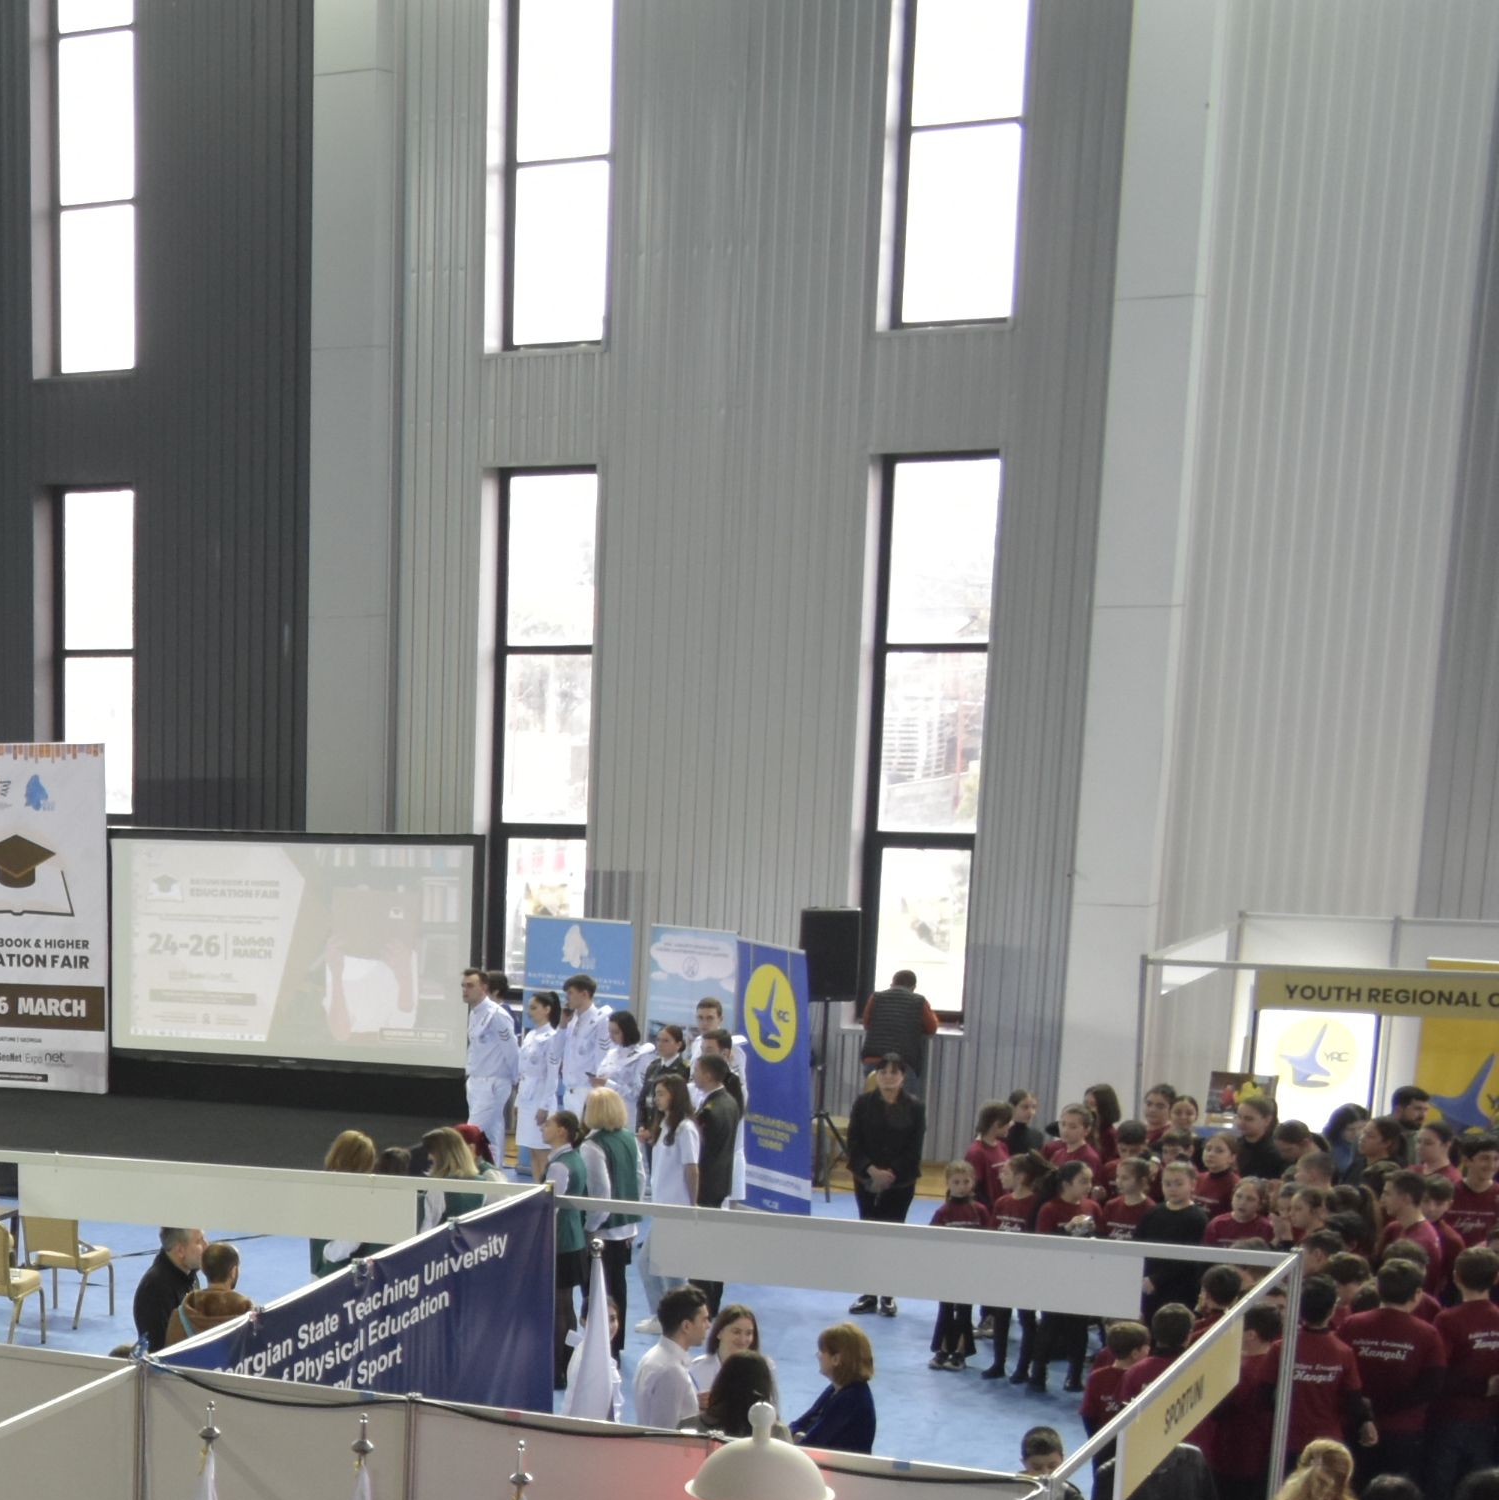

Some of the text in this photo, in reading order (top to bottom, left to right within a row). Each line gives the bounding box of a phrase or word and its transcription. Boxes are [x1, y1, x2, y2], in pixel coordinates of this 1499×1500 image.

[190, 888, 280, 899] EDUCATION FAIR
[34, 939, 42, 948] &
[45, 939, 89, 950] HIGHER
[148, 932, 220, 957] 24-26
[232, 948, 272, 959] MARCH
[51, 954, 90, 969] FAIR
[1286, 984, 1361, 1001] YOUTH
[1368, 988, 1481, 1008] REGIONAL
[17, 997, 86, 1017] MARCH
[25, 1053, 43, 1065] Expo
[44, 1052, 66, 1063] net
[1324, 1052, 1349, 1062] YRC
[297, 1312, 339, 1349] State
[343, 1274, 420, 1323] Teaching
[424, 1233, 509, 1286] University
[293, 1329, 364, 1383] Physical
[368, 1291, 450, 1346] Education
[357, 1343, 403, 1387] Sport
